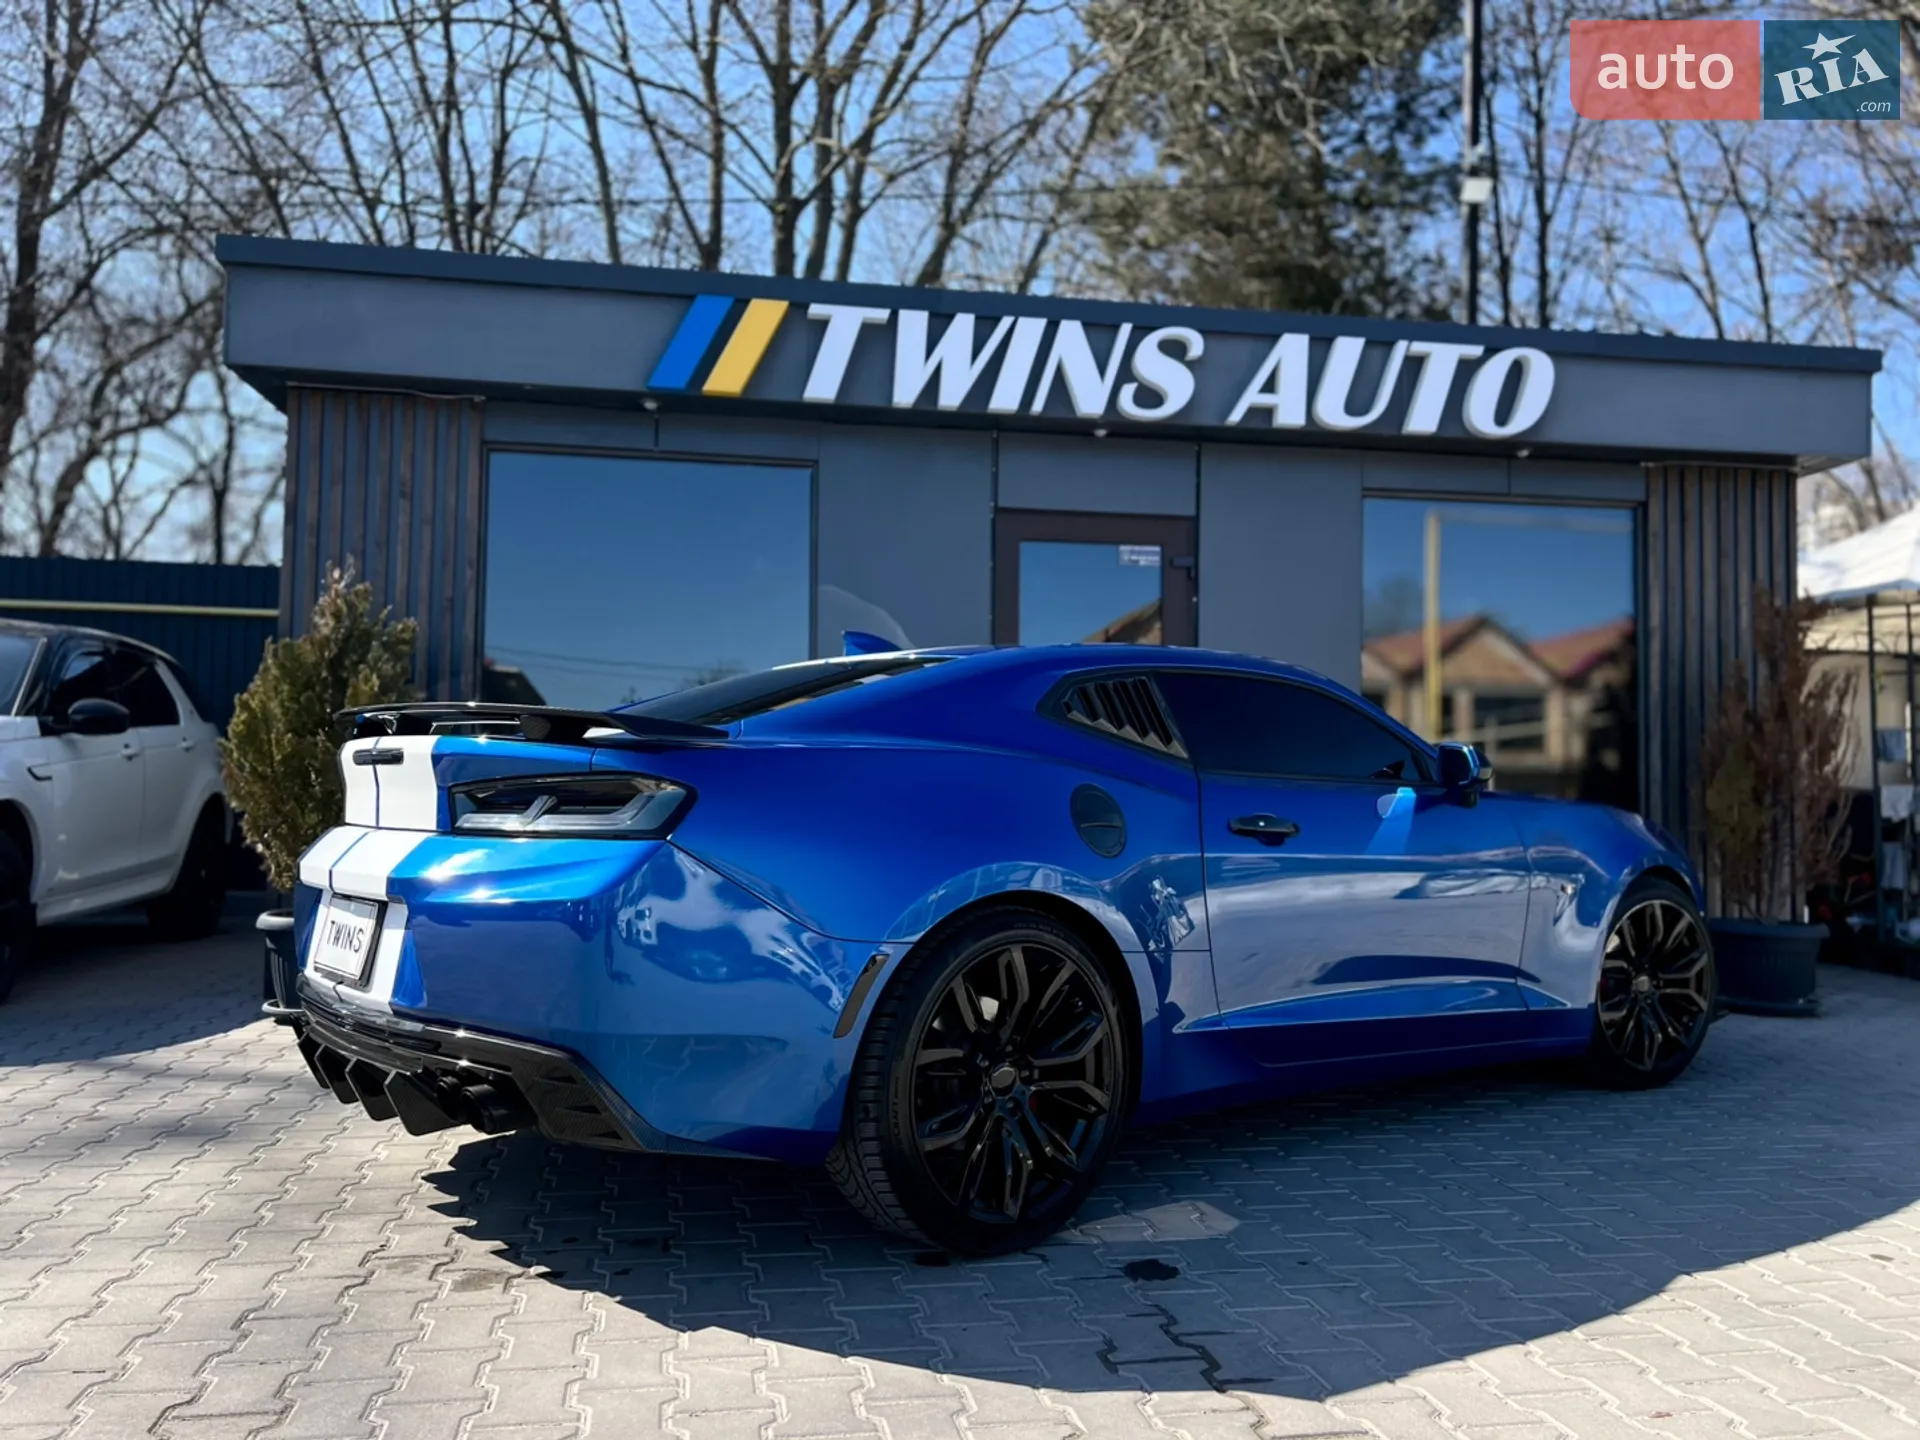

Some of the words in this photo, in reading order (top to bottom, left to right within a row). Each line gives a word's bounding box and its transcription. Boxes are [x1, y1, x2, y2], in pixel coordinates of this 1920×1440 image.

[803, 302, 1205, 422] TWINS
[1224, 332, 1556, 439] AUTO
[327, 920, 364, 953] TWINS
